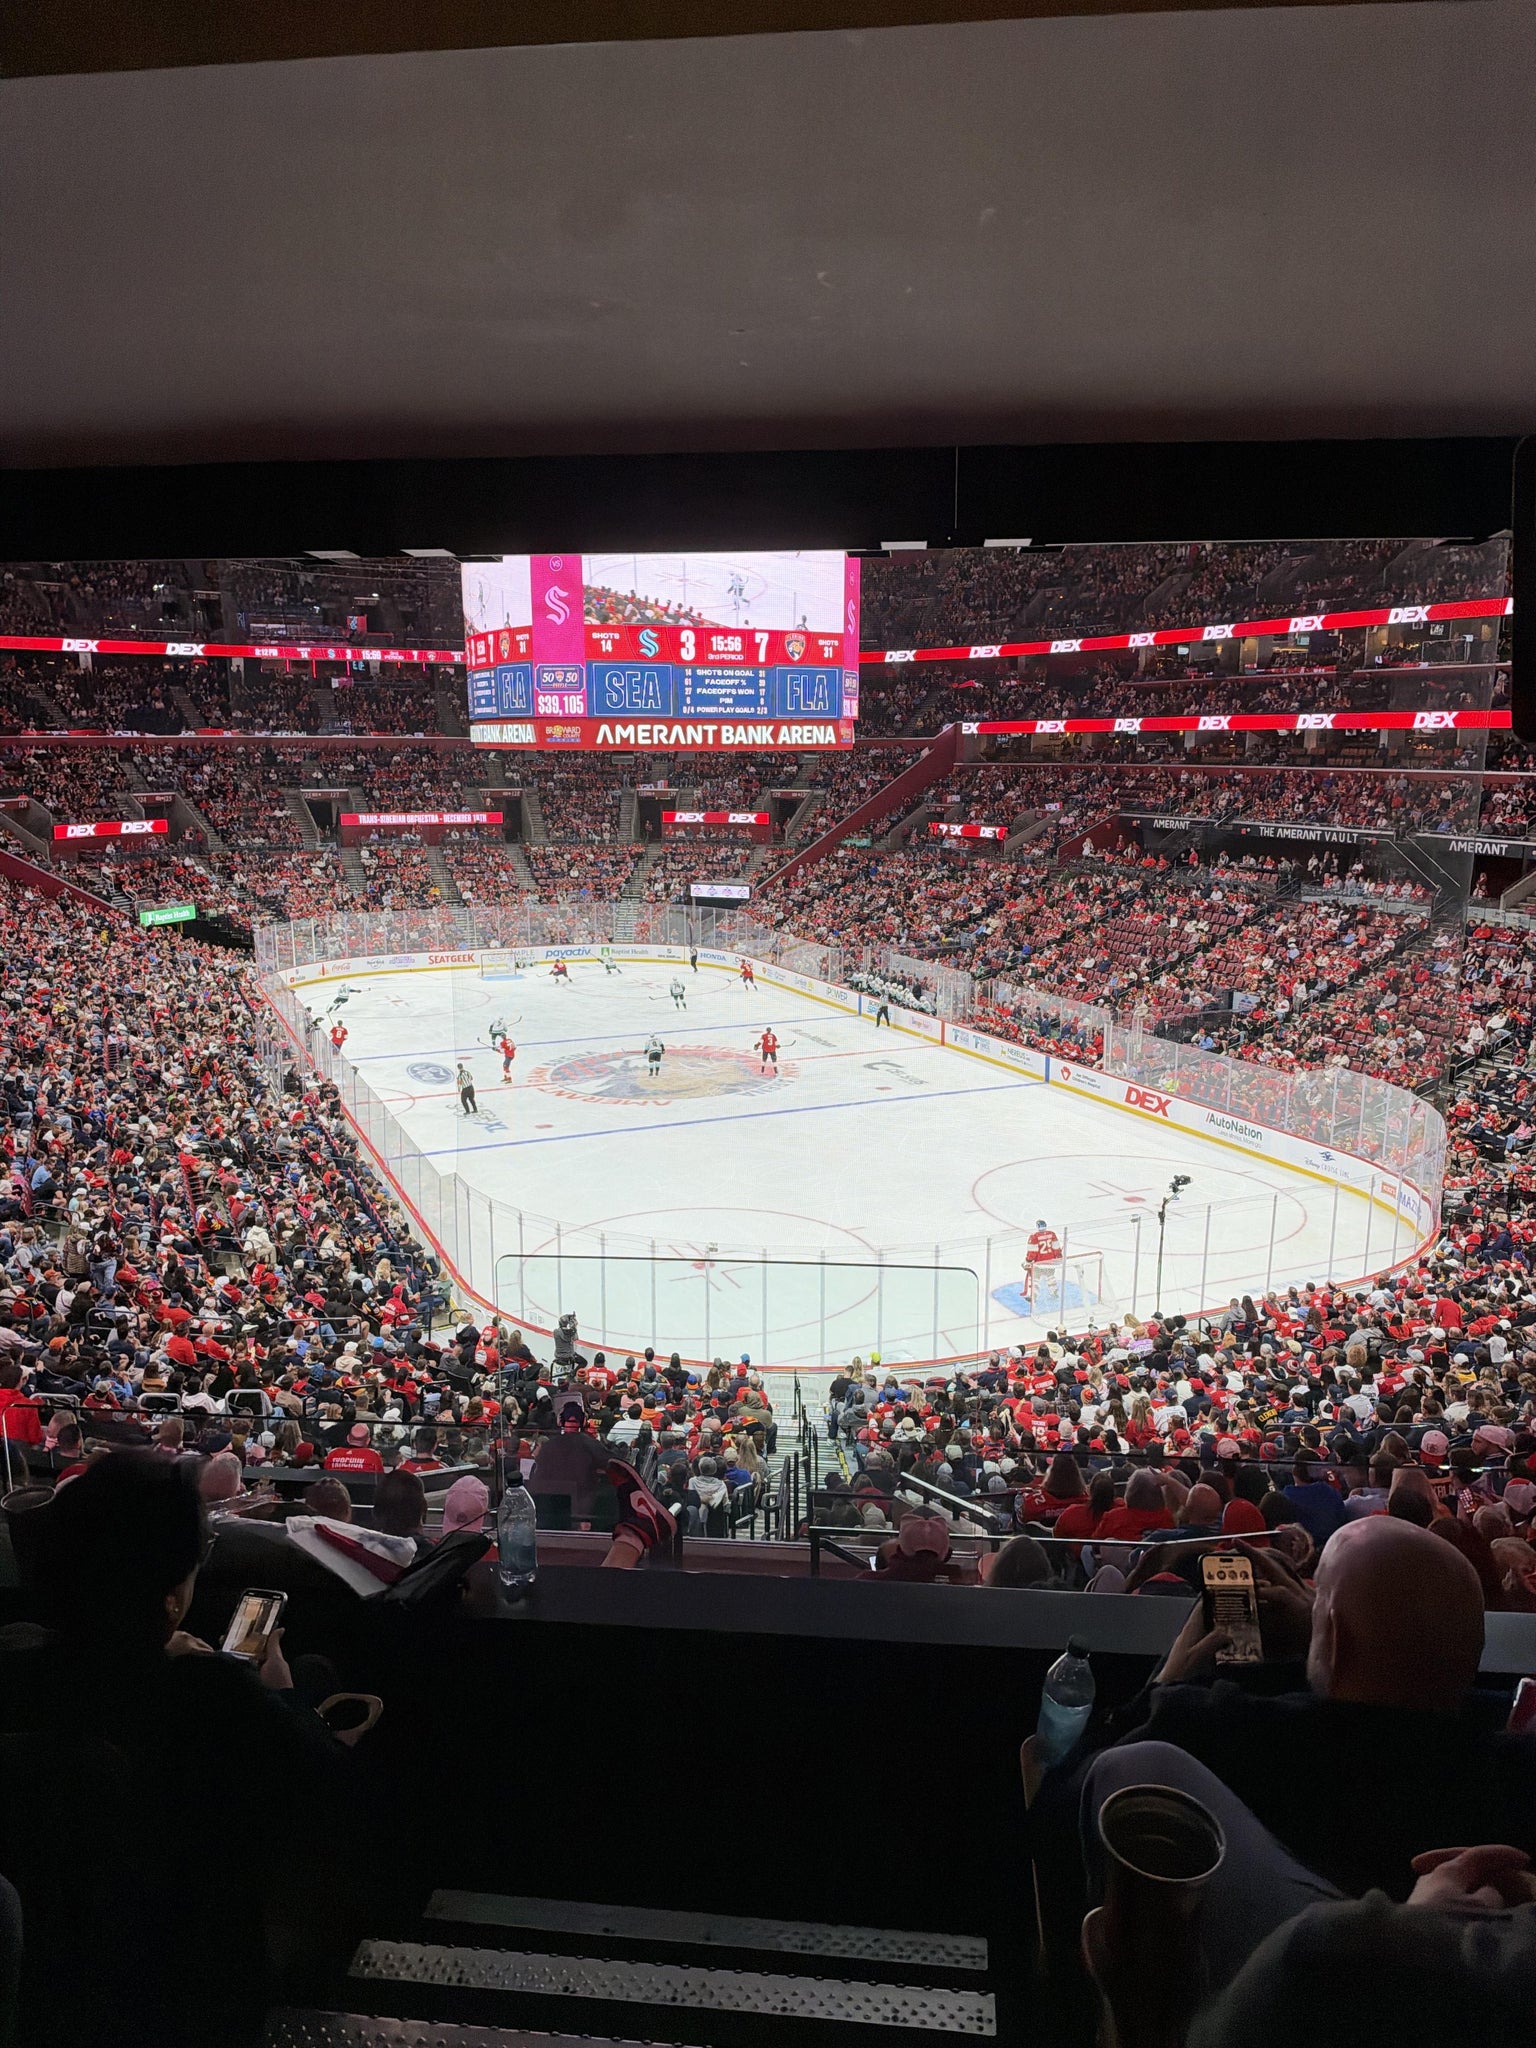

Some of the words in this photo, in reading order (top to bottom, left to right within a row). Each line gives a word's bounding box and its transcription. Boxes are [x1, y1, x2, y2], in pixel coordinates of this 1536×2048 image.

[1388, 605, 1432, 625] DEX
[1288, 615, 1326, 633] DEX
[592, 632, 620, 640] SHOTS
[1202, 624, 1236, 640] DEX
[62, 639, 99, 652] DEX
[601, 640, 613, 652] 14
[680, 630, 696, 661] 3
[711, 636, 742, 652] 15:56
[1050, 639, 1083, 653] DEX
[1128, 632, 1157, 647] DEX
[166, 643, 205, 656] DEX
[755, 632, 769, 662] 7
[824, 646, 832, 658] 31
[969, 645, 1002, 658] DEX
[885, 650, 917, 662] DEX
[542, 672, 554, 683] 50
[565, 672, 578, 683] 50
[502, 672, 526, 709] FLA
[606, 670, 661, 709] SEA
[788, 674, 829, 711] FLA
[538, 695, 584, 716] $39,105
[1035, 720, 1068, 733] DEX
[1114, 718, 1144, 732] DEX
[1198, 716, 1232, 730] DEX
[1296, 714, 1337, 728] DEX
[1413, 712, 1459, 728] DEX
[502, 724, 536, 743] ARENA
[596, 724, 718, 745] AMERANT
[722, 724, 774, 744] BANK
[777, 725, 836, 744] ARENA
[962, 722, 980, 734] EX
[406, 814, 438, 823] ORCHESTRA
[674, 812, 705, 822] DEX
[728, 813, 758, 824] DEX
[1153, 819, 1190, 830] AMERANT
[66, 823, 96, 837] DEX
[120, 821, 154, 834] DEX
[1259, 826, 1275, 838] THE
[1276, 828, 1322, 840] AMERANT
[1324, 832, 1358, 844] VAULT
[1449, 840, 1508, 856] AMERANT
[428, 953, 475, 964] SEATGEEK
[545, 947, 592, 959] payactiv
[700, 952, 727, 961] HONDA
[336, 1030, 342, 1038] 8
[768, 1038, 773, 1046] 3
[1125, 1086, 1172, 1118] DEX
